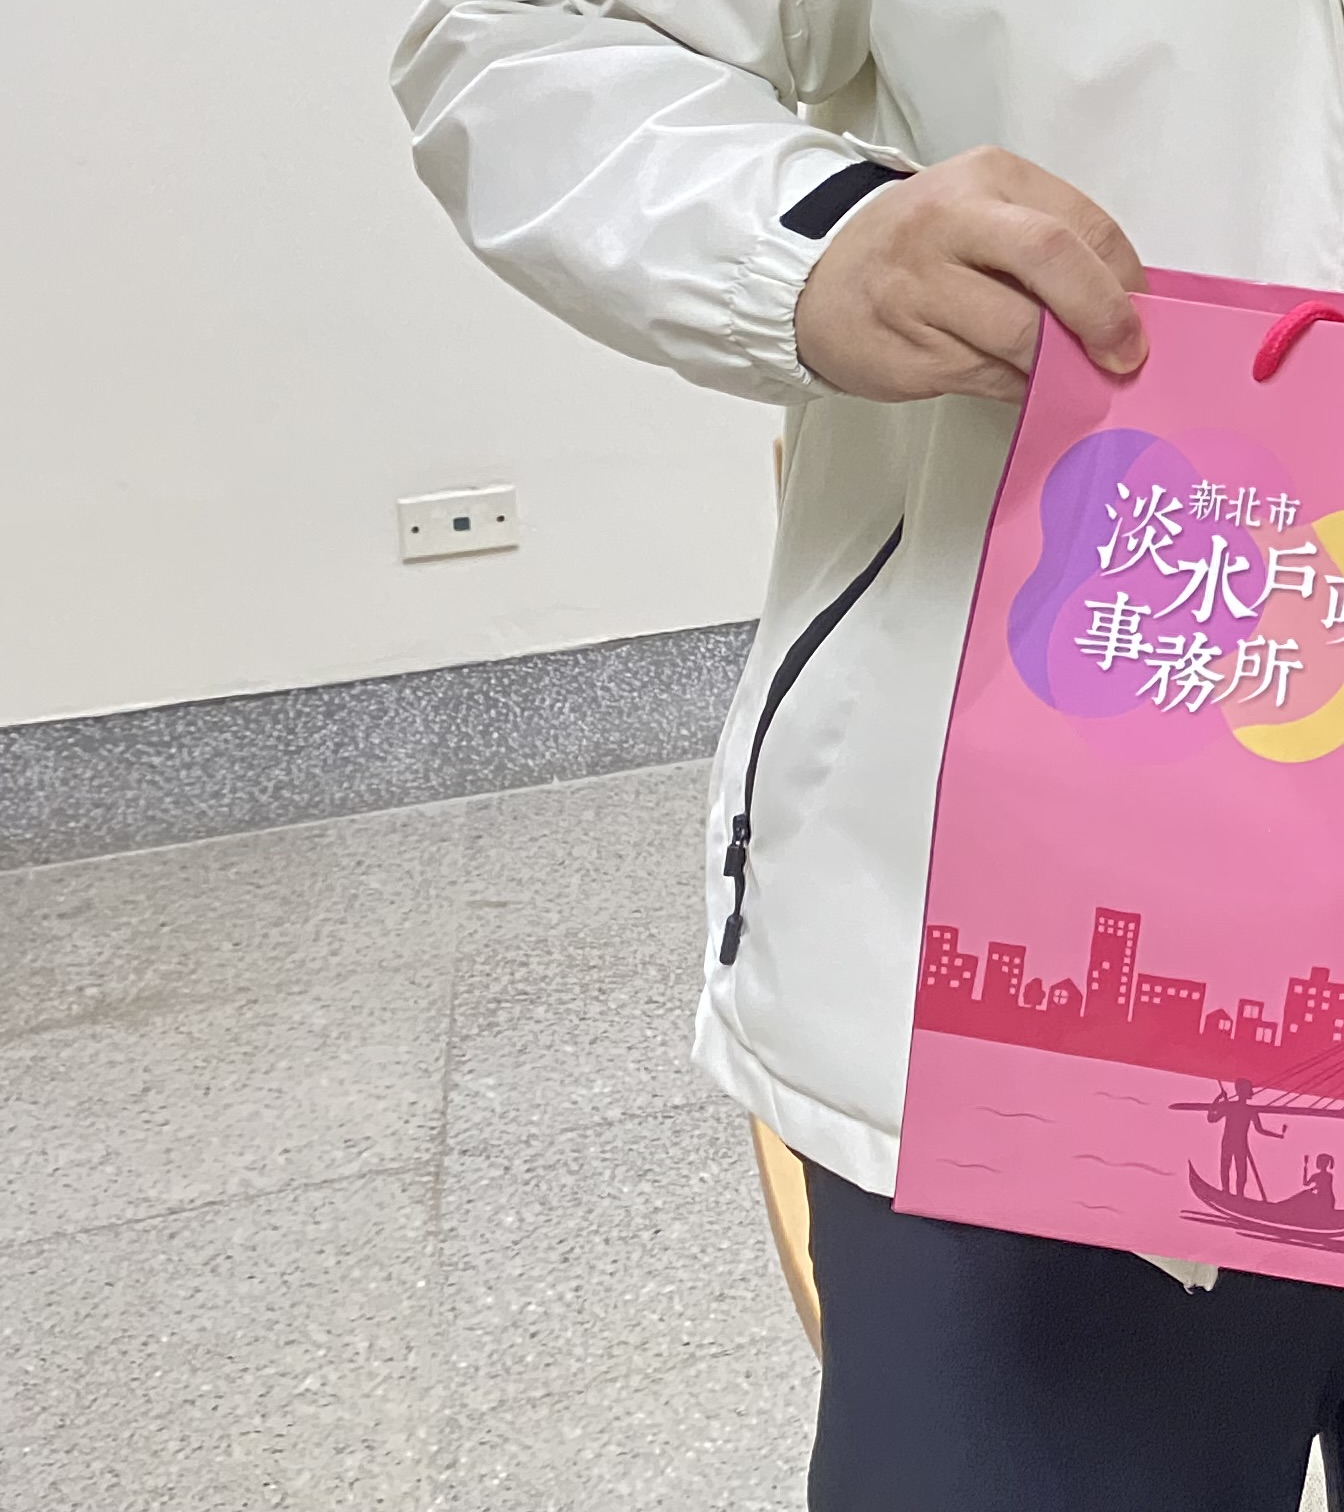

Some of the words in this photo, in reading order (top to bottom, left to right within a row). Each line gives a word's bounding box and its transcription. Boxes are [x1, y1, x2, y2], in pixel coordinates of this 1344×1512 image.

[1187, 478, 1302, 535] 新北市
[1073, 591, 1305, 714] 事務所
